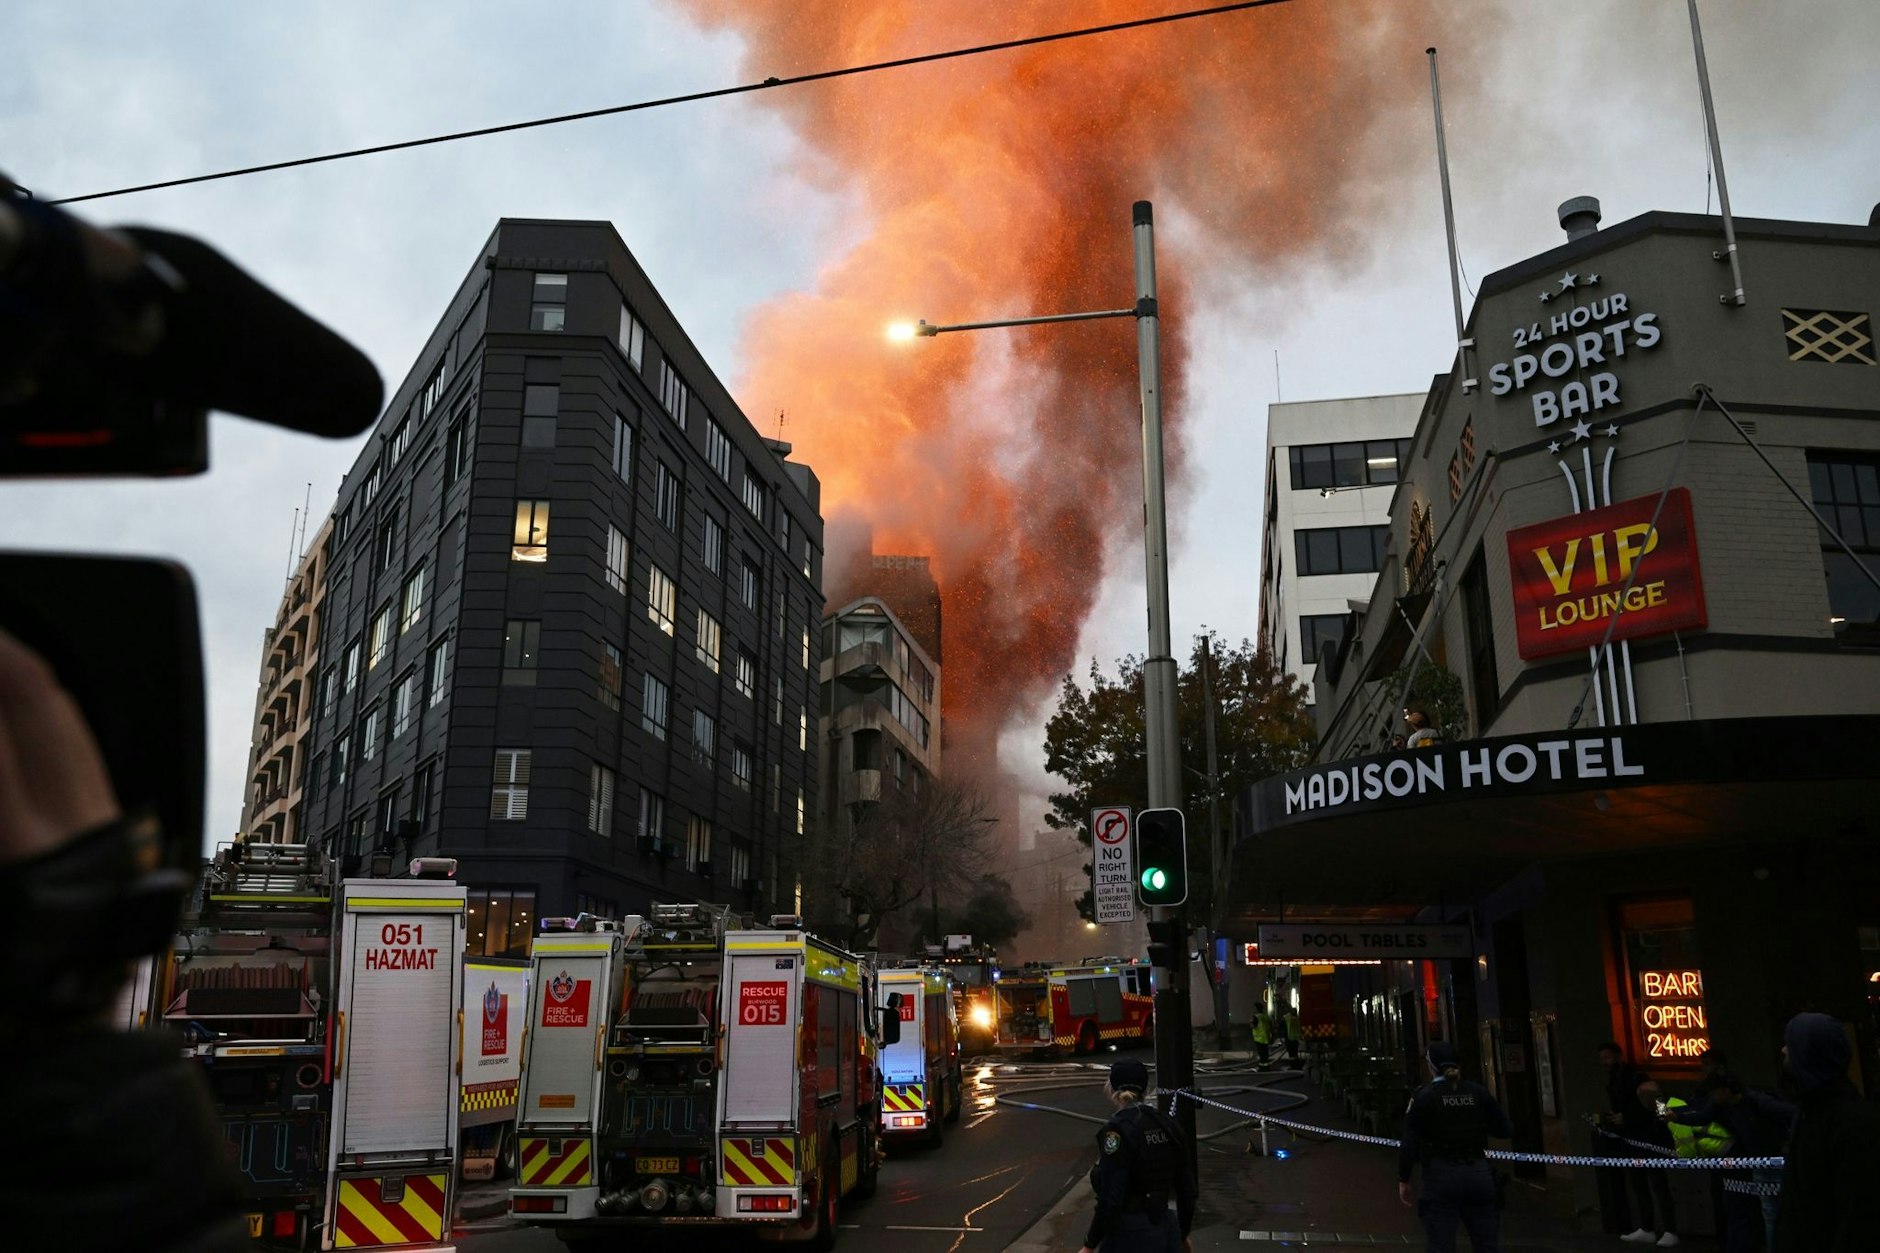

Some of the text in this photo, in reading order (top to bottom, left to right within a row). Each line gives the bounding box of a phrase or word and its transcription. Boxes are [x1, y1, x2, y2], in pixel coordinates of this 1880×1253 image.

[1512, 293, 1628, 349] 24 HOUR
[1488, 312, 1661, 396] SPORTS
[1532, 372, 1622, 428] BAR
[1532, 522, 1658, 597] VIP
[1538, 580, 1668, 631] LOUNGE
[1285, 736, 1645, 815] MADISON HOTEL
[1102, 848, 1122, 860] NO
[1099, 863, 1126, 872] RIGHT
[1101, 874, 1126, 883] TURN
[1098, 887, 1114, 895] LIGHT
[1098, 895, 1131, 903] AUTHORISED
[1101, 902, 1127, 910] VEHICLE
[1100, 910, 1131, 919] EXCEPTED
[382, 924, 422, 945] 051
[1302, 934, 1353, 948] POOL
[1360, 934, 1427, 948] TABLES
[366, 949, 438, 970] HAZMAT
[1644, 972, 1699, 997] BAR
[742, 987, 786, 997] RESCUE
[546, 1015, 584, 1023] RESCUE
[743, 1004, 781, 1023] 015
[1643, 1005, 1704, 1028] OPEN
[484, 1039, 505, 1050] RESCUE
[1442, 1097, 1475, 1107] POLICE
